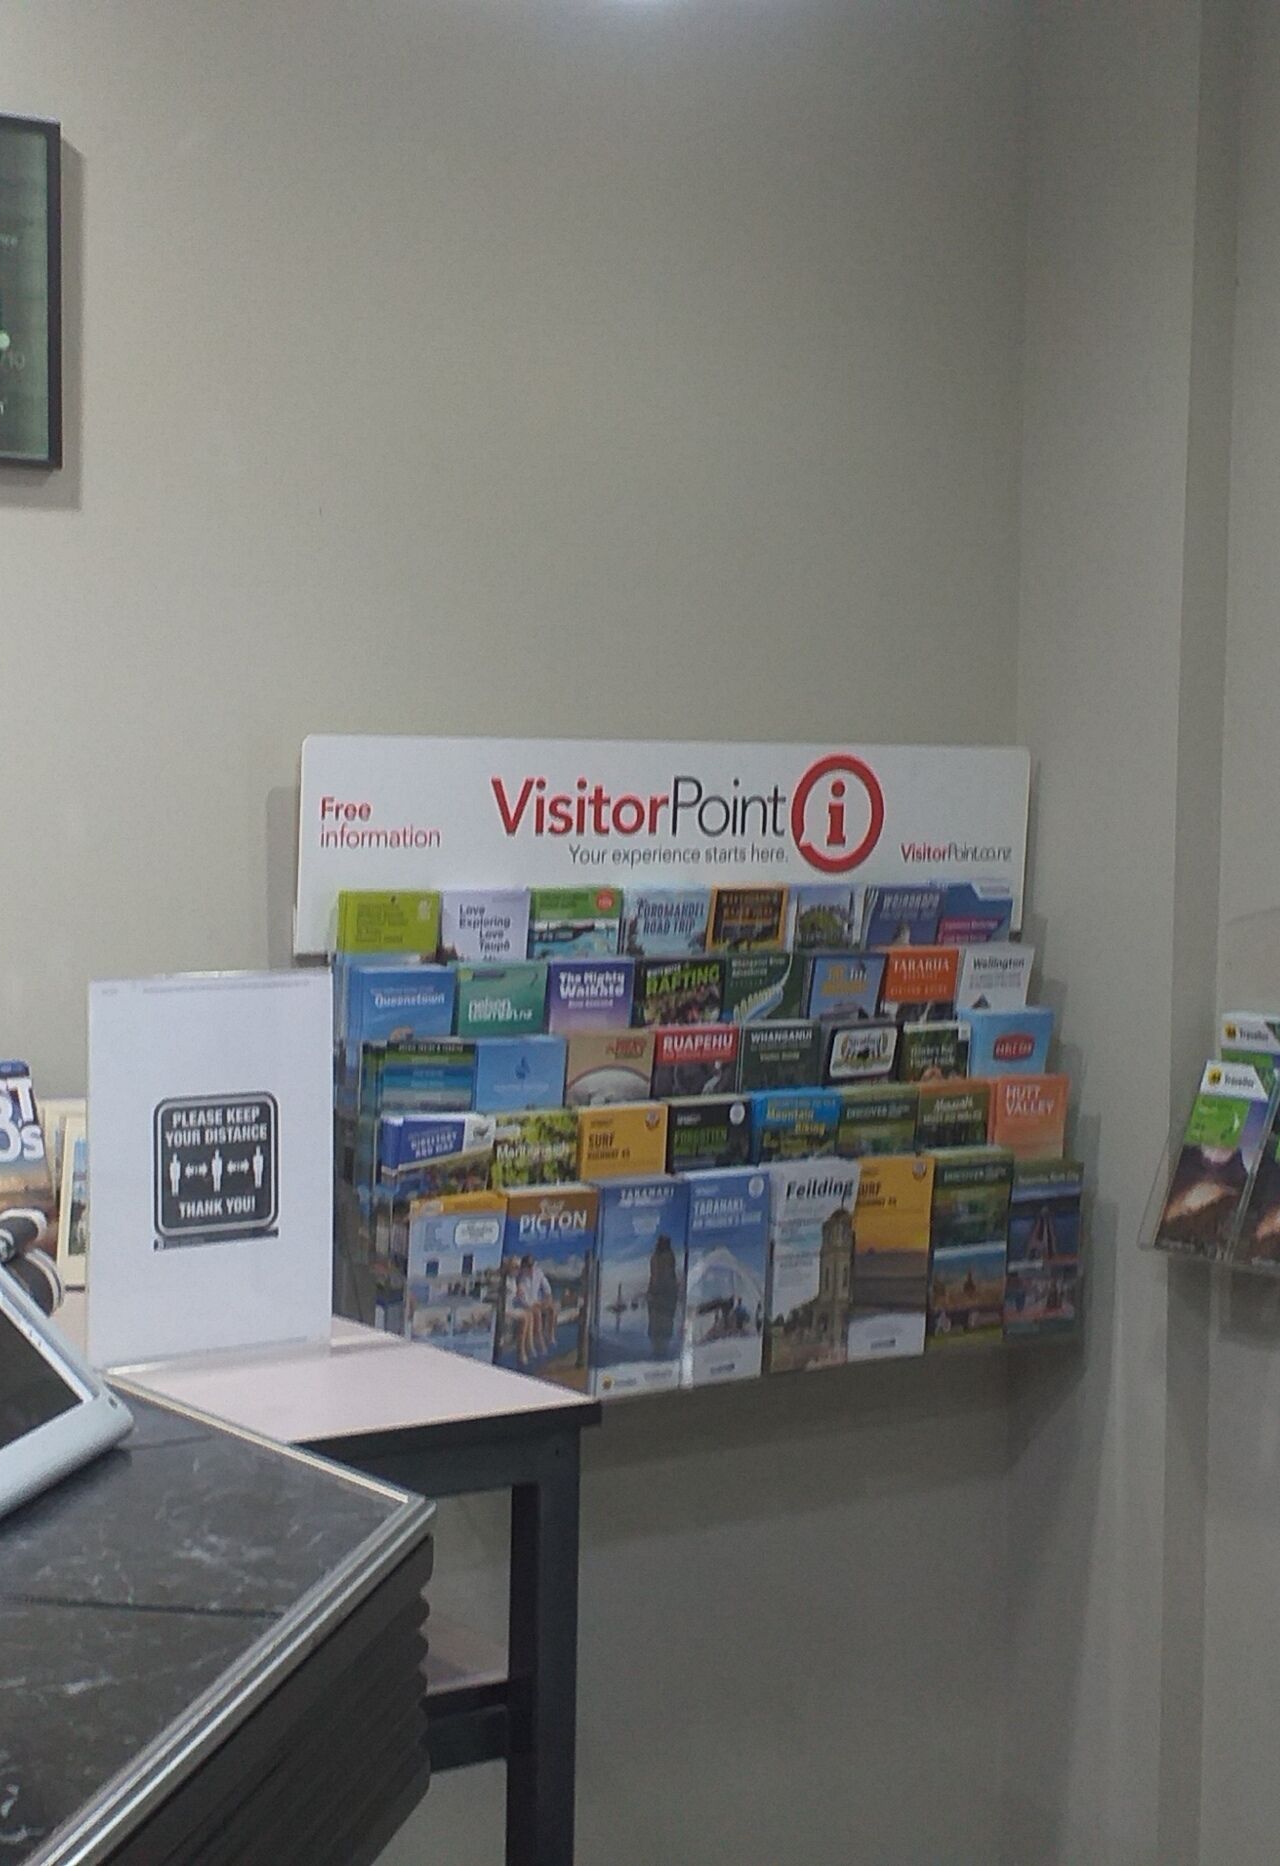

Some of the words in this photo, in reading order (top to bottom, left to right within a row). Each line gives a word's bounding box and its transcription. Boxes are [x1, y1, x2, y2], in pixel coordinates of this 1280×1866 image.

[321, 796, 372, 822] Free
[490, 775, 787, 838] VisitorPoint
[321, 823, 441, 849] information
[569, 843, 605, 866] Your
[611, 845, 701, 869] experience
[704, 846, 746, 865] starts
[750, 842, 789, 865] here.
[899, 842, 1013, 863] VisitorPoint.co.nz
[458, 903, 486, 916] Love
[458, 917, 512, 930] Exploring
[478, 927, 505, 939] Love
[643, 918, 671, 937] ROAD
[673, 918, 697, 936] TRIP
[559, 971, 582, 985] The
[583, 970, 626, 987] Mighty
[646, 963, 721, 996] RAFTING
[559, 983, 625, 1001] Waikato
[662, 1032, 734, 1052] RUAPEHU
[1006, 1084, 1041, 1100] HUTT
[172, 1108, 223, 1129] PLEASE
[226, 1106, 261, 1125] KEEP
[1006, 1098, 1055, 1117] VALLEY
[164, 1128, 201, 1148] YOUR
[205, 1122, 268, 1145] DISTANCE
[786, 1176, 855, 1201] Feilding
[178, 1197, 223, 1219] THANK
[225, 1194, 256, 1215] YOU!
[519, 1209, 588, 1236] PICTON
